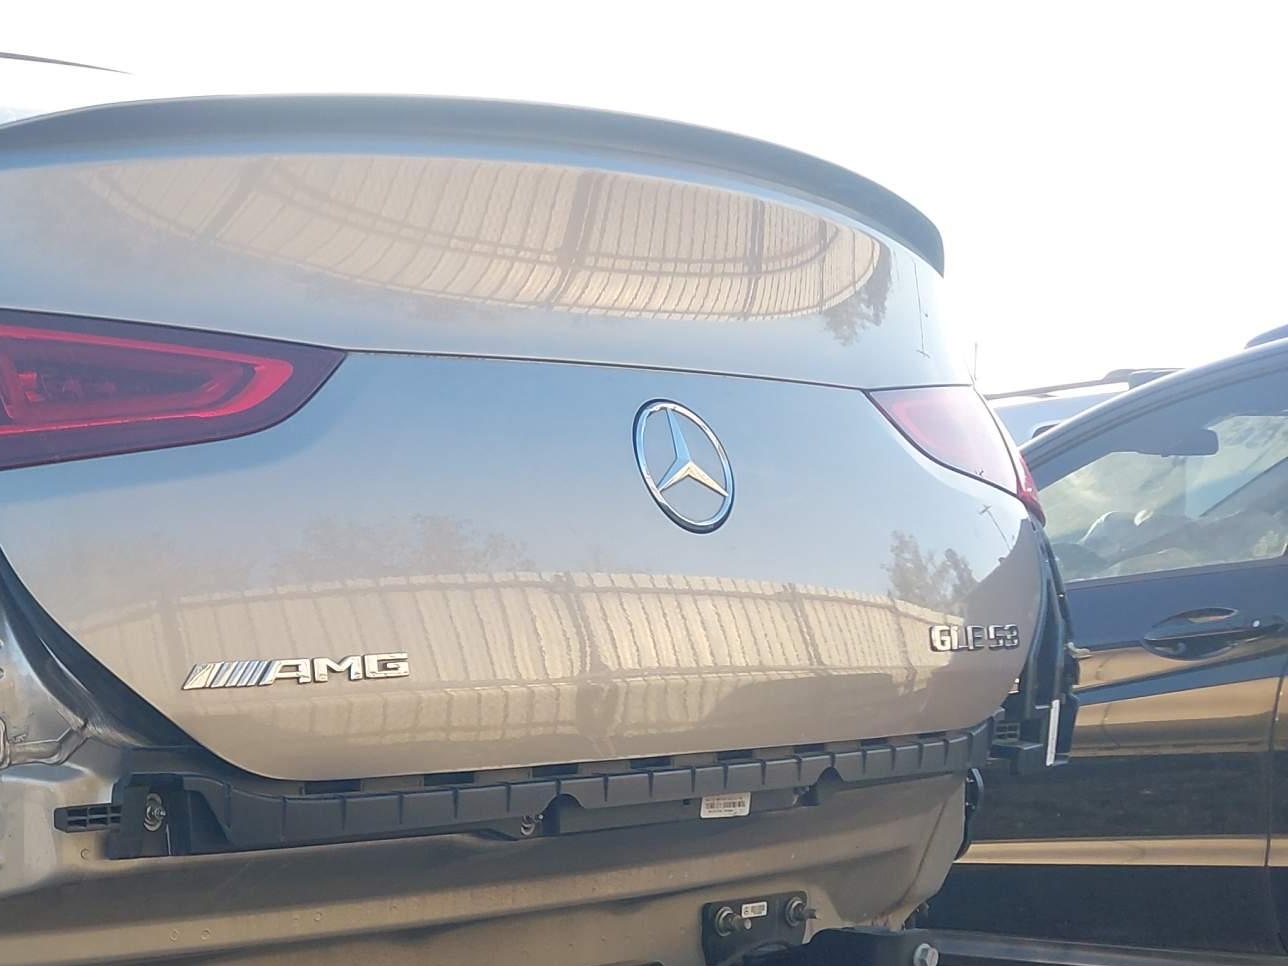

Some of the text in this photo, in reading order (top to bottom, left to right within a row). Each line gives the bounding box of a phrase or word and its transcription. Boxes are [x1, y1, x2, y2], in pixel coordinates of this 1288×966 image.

[929, 623, 1019, 651] GLE 53
[258, 652, 410, 686] AMG
